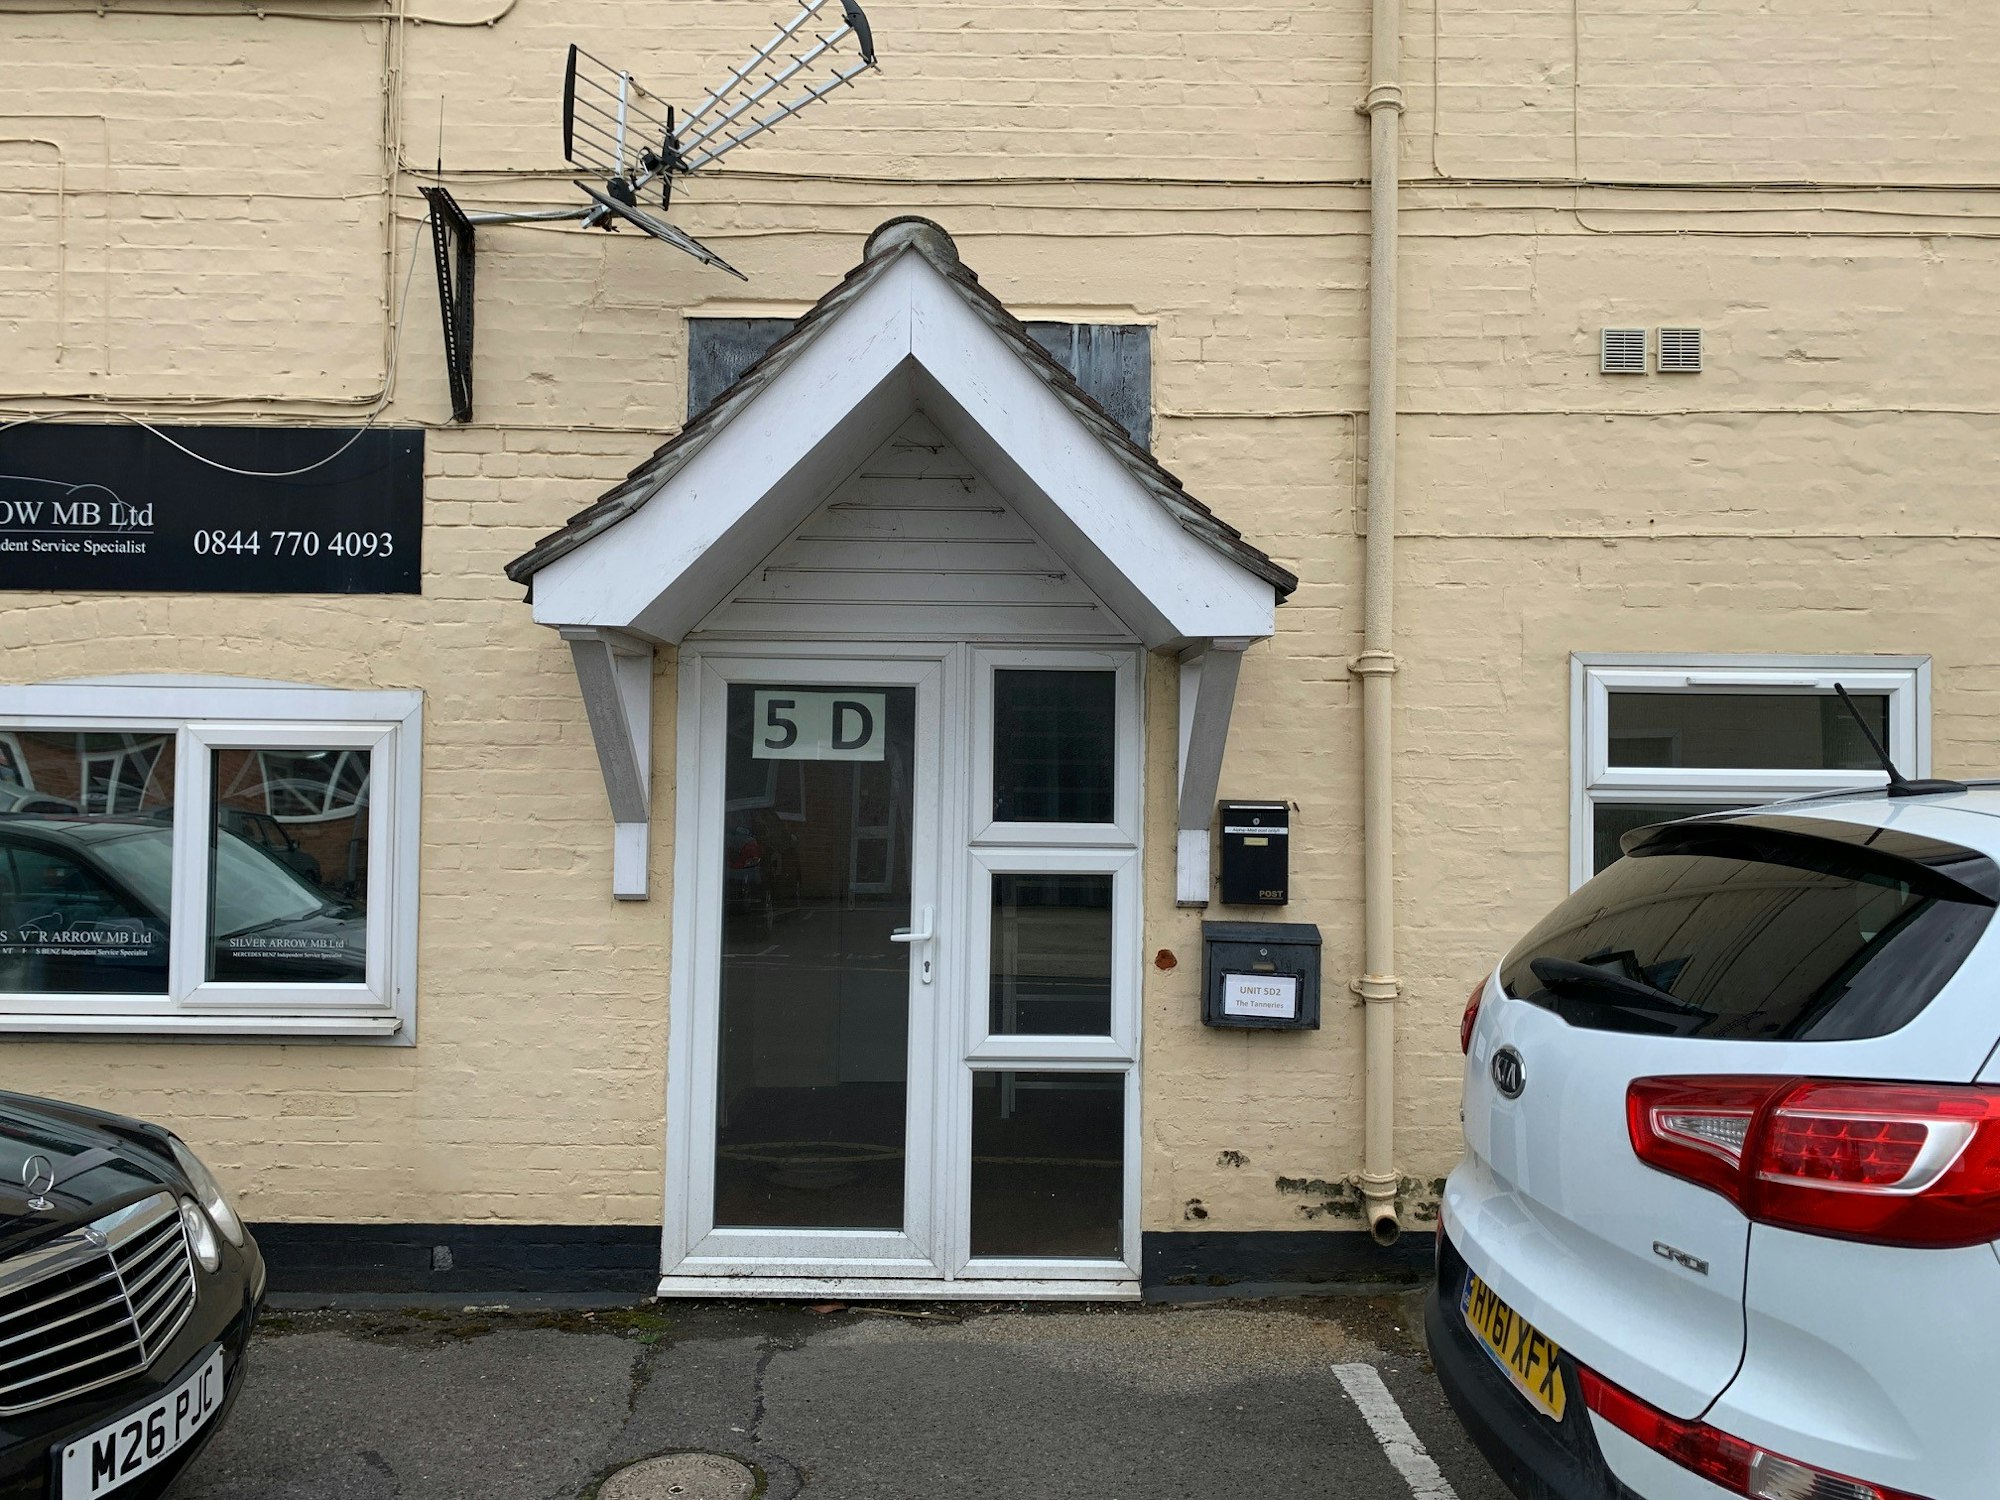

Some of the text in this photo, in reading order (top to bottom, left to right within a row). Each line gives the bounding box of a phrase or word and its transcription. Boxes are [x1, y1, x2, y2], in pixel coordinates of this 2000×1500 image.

[51, 501, 101, 526] MB
[108, 502, 154, 527] Ltd
[32, 539, 80, 553] Service
[83, 539, 146, 556] Specialist
[193, 529, 394, 558] 0844 770 4093
[764, 699, 873, 750] 5 D
[1259, 890, 1284, 898] POST
[51, 930, 104, 943] ARROW
[107, 931, 129, 944] MB
[132, 931, 152, 944] Ltd
[229, 938, 344, 949] SILVER ARROW MB Ltd
[1240, 986, 1281, 996] UNIT 5D2
[1236, 999, 1284, 1009] The Tanneries
[1473, 1278, 1512, 1354] HY61
[1511, 1315, 1560, 1403] XFX
[92, 1364, 213, 1491] M26 PJC
